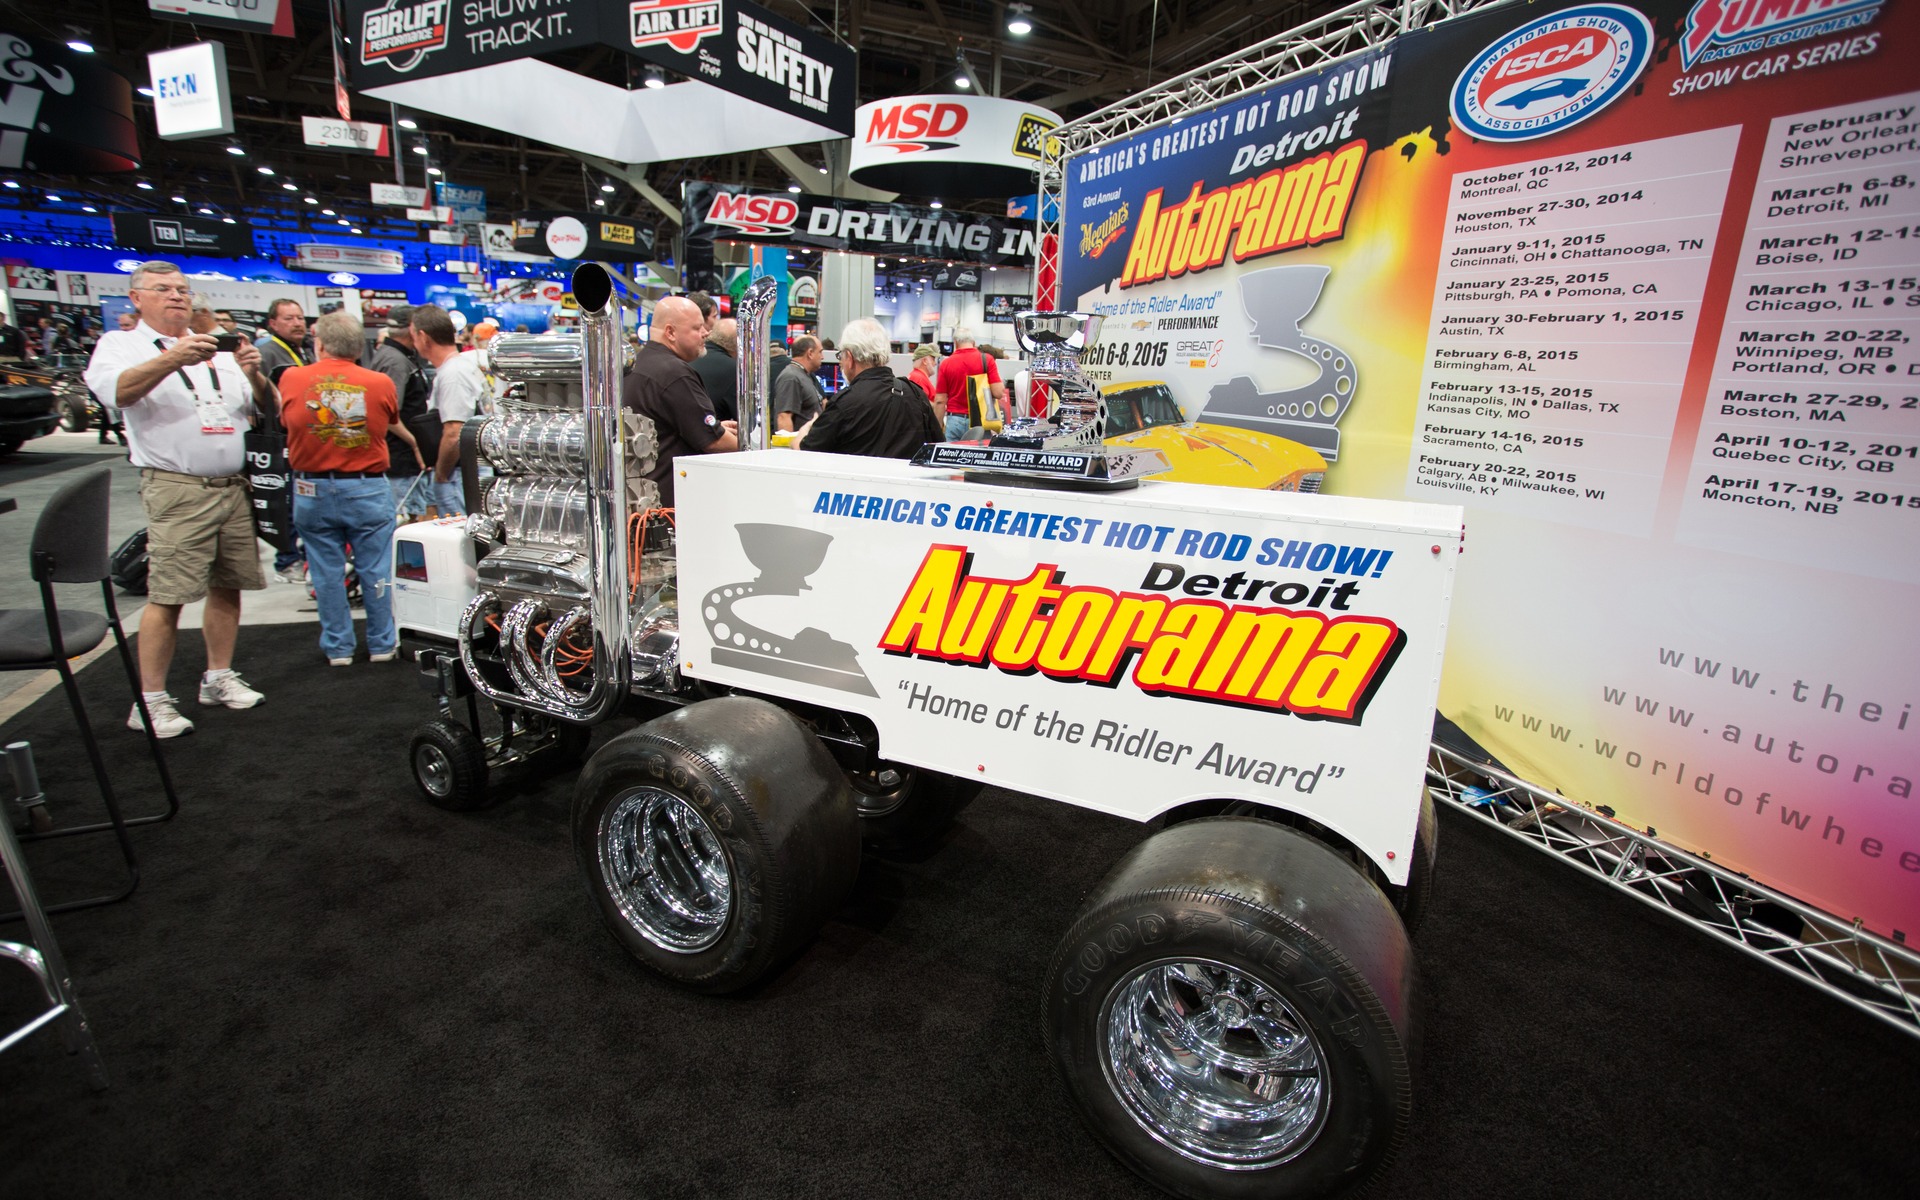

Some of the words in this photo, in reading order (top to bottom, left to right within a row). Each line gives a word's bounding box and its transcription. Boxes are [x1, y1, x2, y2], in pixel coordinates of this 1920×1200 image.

[638, 11, 674, 35] AIR
[678, 6, 717, 29] LIFT
[465, 18, 543, 54] TRACK
[547, 13, 572, 37] IT.
[1701, 38, 1765, 63] RACING
[1765, 8, 1879, 48] EQUIPMENT
[737, 27, 833, 102] SAFETY
[1468, 20, 1569, 112] INTERNATIONAL
[1577, 18, 1621, 35] SHOW
[1609, 40, 1629, 79] CAR
[1495, 35, 1594, 80] ISCA
[1669, 66, 1740, 96] SHOW
[1742, 54, 1790, 80] CAR
[1793, 33, 1881, 69] SERIES
[699, 62, 721, 78] 1949
[866, 103, 969, 143] MSD
[1080, 142, 1146, 183] AMERICA'S
[1152, 116, 1230, 161] GREATEST
[1234, 100, 1270, 136] HOT
[1278, 85, 1311, 120] ROD
[1325, 55, 1391, 102] SHOW
[1485, 94, 1593, 129] ASSOCIATION
[1788, 105, 1916, 136] February
[1229, 106, 1360, 175] Detroit
[1783, 136, 1835, 152] New
[1462, 171, 1524, 187] October
[1529, 162, 1580, 177] 10-12,
[1586, 152, 1633, 169] 2014
[1461, 183, 1521, 199] Montreal,
[1527, 179, 1549, 190] QC
[1771, 183, 1852, 201] March
[1863, 175, 1916, 191] 6-8,
[1119, 138, 1368, 290] Autorama
[1456, 205, 1533, 222] November
[1538, 198, 1591, 213] 27-30,
[1596, 190, 1644, 205] 2014
[1767, 199, 1850, 218] Detroit,
[1859, 194, 1889, 208] MI
[706, 192, 798, 225] MSD
[808, 207, 991, 251] DRIVING
[1455, 221, 1513, 234] Houston,
[1518, 217, 1537, 227] TX
[1450, 254, 1519, 268] Cincinnati,
[1523, 252, 1546, 262] OH
[1561, 243, 1671, 260] Chattanooga,
[1678, 239, 1704, 250] TN
[1452, 243, 1512, 257] January
[1517, 239, 1556, 250] 9-11,
[1561, 234, 1606, 247] 2015
[1759, 234, 1839, 250] March
[1756, 252, 1823, 265] Boise,
[1833, 248, 1858, 260] ID
[1446, 279, 1505, 290] January
[1510, 276, 1559, 287] 23-25,
[1565, 272, 1610, 284] 2015
[1749, 283, 1827, 296] March
[1445, 290, 1514, 302] Pittsburgh,
[1520, 289, 1538, 298] PA
[1557, 285, 1626, 298] Pomona,
[1632, 284, 1658, 293] CA
[1745, 300, 1842, 312] Chicago,
[1851, 297, 1873, 308] IL
[1120, 302, 1129, 315] of
[1131, 301, 1144, 314] the
[1148, 296, 1178, 313] Ridler
[1158, 316, 1219, 330] PERFORMANCE
[1441, 315, 1500, 325] January
[1505, 313, 1606, 324] 30-February
[1612, 312, 1627, 323] 1,
[1633, 310, 1684, 321] 2015
[1439, 326, 1483, 336] Austin,
[1487, 326, 1505, 335] TX
[1739, 331, 1815, 342] March
[1824, 330, 1909, 344] 20-22,
[1107, 343, 1130, 367] 6-8,
[1132, 342, 1168, 366] 2015
[1176, 341, 1214, 351] GREAT
[1435, 349, 1498, 360] February
[1503, 350, 1531, 360] 6-8,
[1537, 350, 1579, 360] 2015
[1736, 346, 1844, 360] Winnipeg,
[1853, 347, 1894, 358] MB
[1434, 360, 1513, 372] Birmingham,
[1517, 362, 1536, 372] AL
[1732, 362, 1828, 376] Portland,
[1838, 363, 1876, 375] OR
[1430, 382, 1493, 394] February
[1498, 385, 1545, 397] 13-15,
[1550, 387, 1593, 398] 2015
[1724, 391, 1798, 403] March
[1806, 394, 1889, 410] 27-29,
[1427, 404, 1471, 414] Kansas
[1475, 407, 1503, 419] City,
[1507, 409, 1530, 419] MO
[1428, 393, 1507, 407] Indianapolis,
[1512, 397, 1526, 406] IN
[1542, 400, 1592, 412] Dallas,
[1598, 403, 1620, 413] TX
[1720, 405, 1800, 421] Boston,
[1809, 410, 1846, 421] MA
[1422, 435, 1498, 452] Sacramento,
[1503, 443, 1523, 454] CA
[1424, 424, 1486, 439] February
[1490, 430, 1537, 444] 14-16,
[1542, 435, 1584, 447] 2015
[1714, 433, 1770, 446] April
[1779, 438, 1856, 455] 10-12,
[939, 449, 959, 458] Detroit
[991, 451, 1034, 463] RIDLER
[1040, 455, 1083, 467] AWARD
[1420, 455, 1481, 472] February
[1484, 463, 1530, 478] 20-22,
[1535, 469, 1576, 483] 2015
[1712, 447, 1791, 463] Quebec
[1798, 455, 1846, 471] City,
[1856, 460, 1894, 473] QB
[1416, 476, 1476, 494] Louisville,
[1480, 486, 1498, 496] KY
[1418, 466, 1464, 480] Calgary,
[1468, 473, 1487, 482] AB
[1502, 477, 1579, 498] Milwaukee,
[1585, 489, 1605, 500] WI
[1705, 475, 1759, 489] April
[1768, 481, 1844, 501] 17-19,
[1853, 491, 1920, 508] 2015
[1702, 489, 1796, 511] Moncton,
[1805, 501, 1838, 514] NB
[954, 505, 1103, 545] GREATEST
[1104, 522, 1176, 552] HOT
[1180, 531, 1250, 561] ROD
[1254, 539, 1394, 579] SHOW!
[1139, 561, 1360, 611] Detroit
[876, 542, 1408, 726] Autorama
[898, 680, 988, 724] “Home
[994, 708, 1029, 733] of
[1031, 712, 1087, 746] the
[1090, 720, 1192, 768] Ridler
[1193, 742, 1345, 795] Award”
